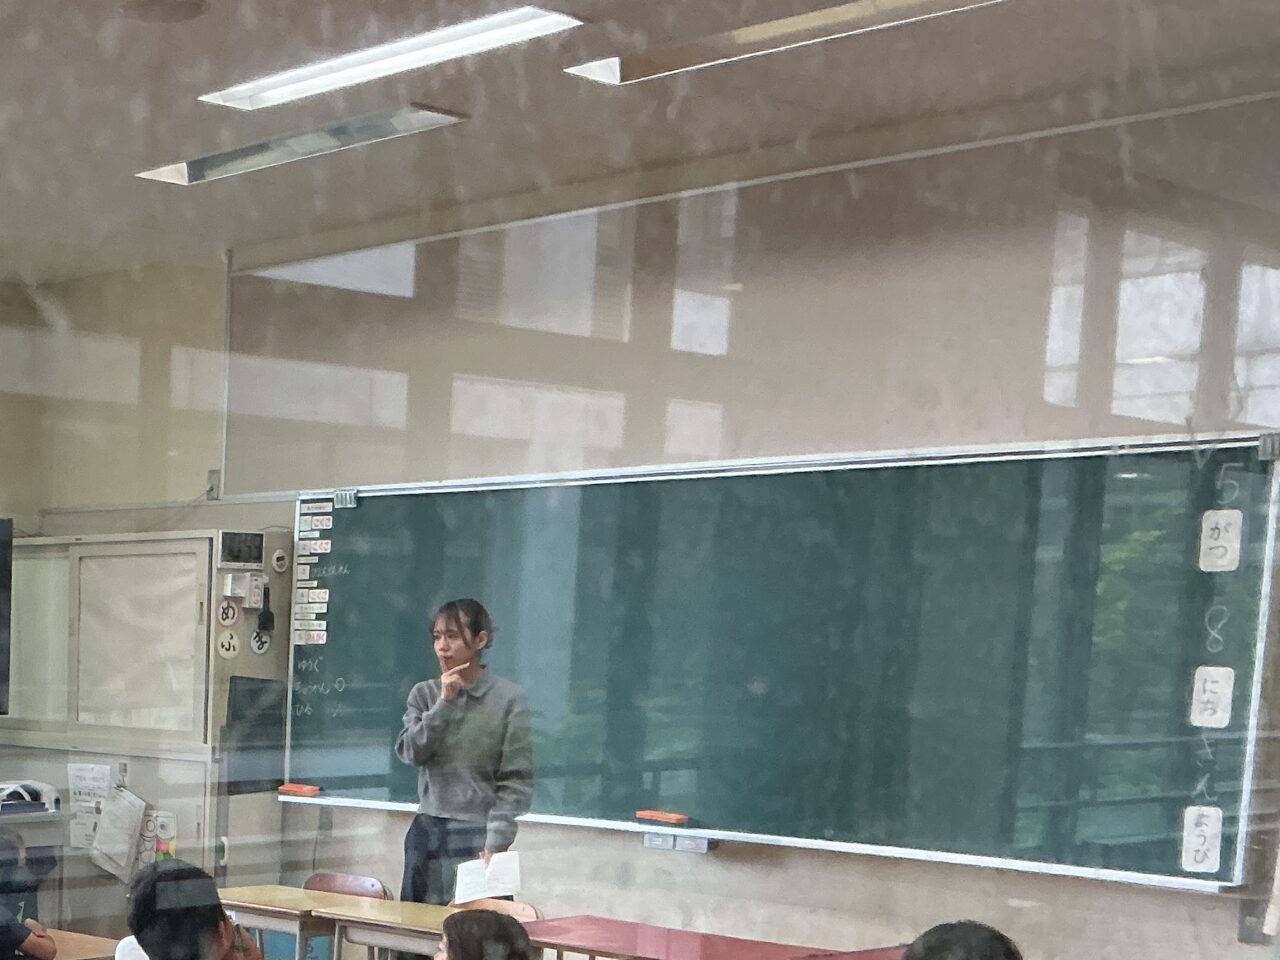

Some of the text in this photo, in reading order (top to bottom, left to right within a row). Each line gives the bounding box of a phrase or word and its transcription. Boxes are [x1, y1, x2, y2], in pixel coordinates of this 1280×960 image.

[1215, 461, 1245, 505] 5
[1207, 521, 1233, 559] がつ
[221, 600, 236, 622] め
[1204, 604, 1231, 654] 8
[220, 633, 236, 652] ふ
